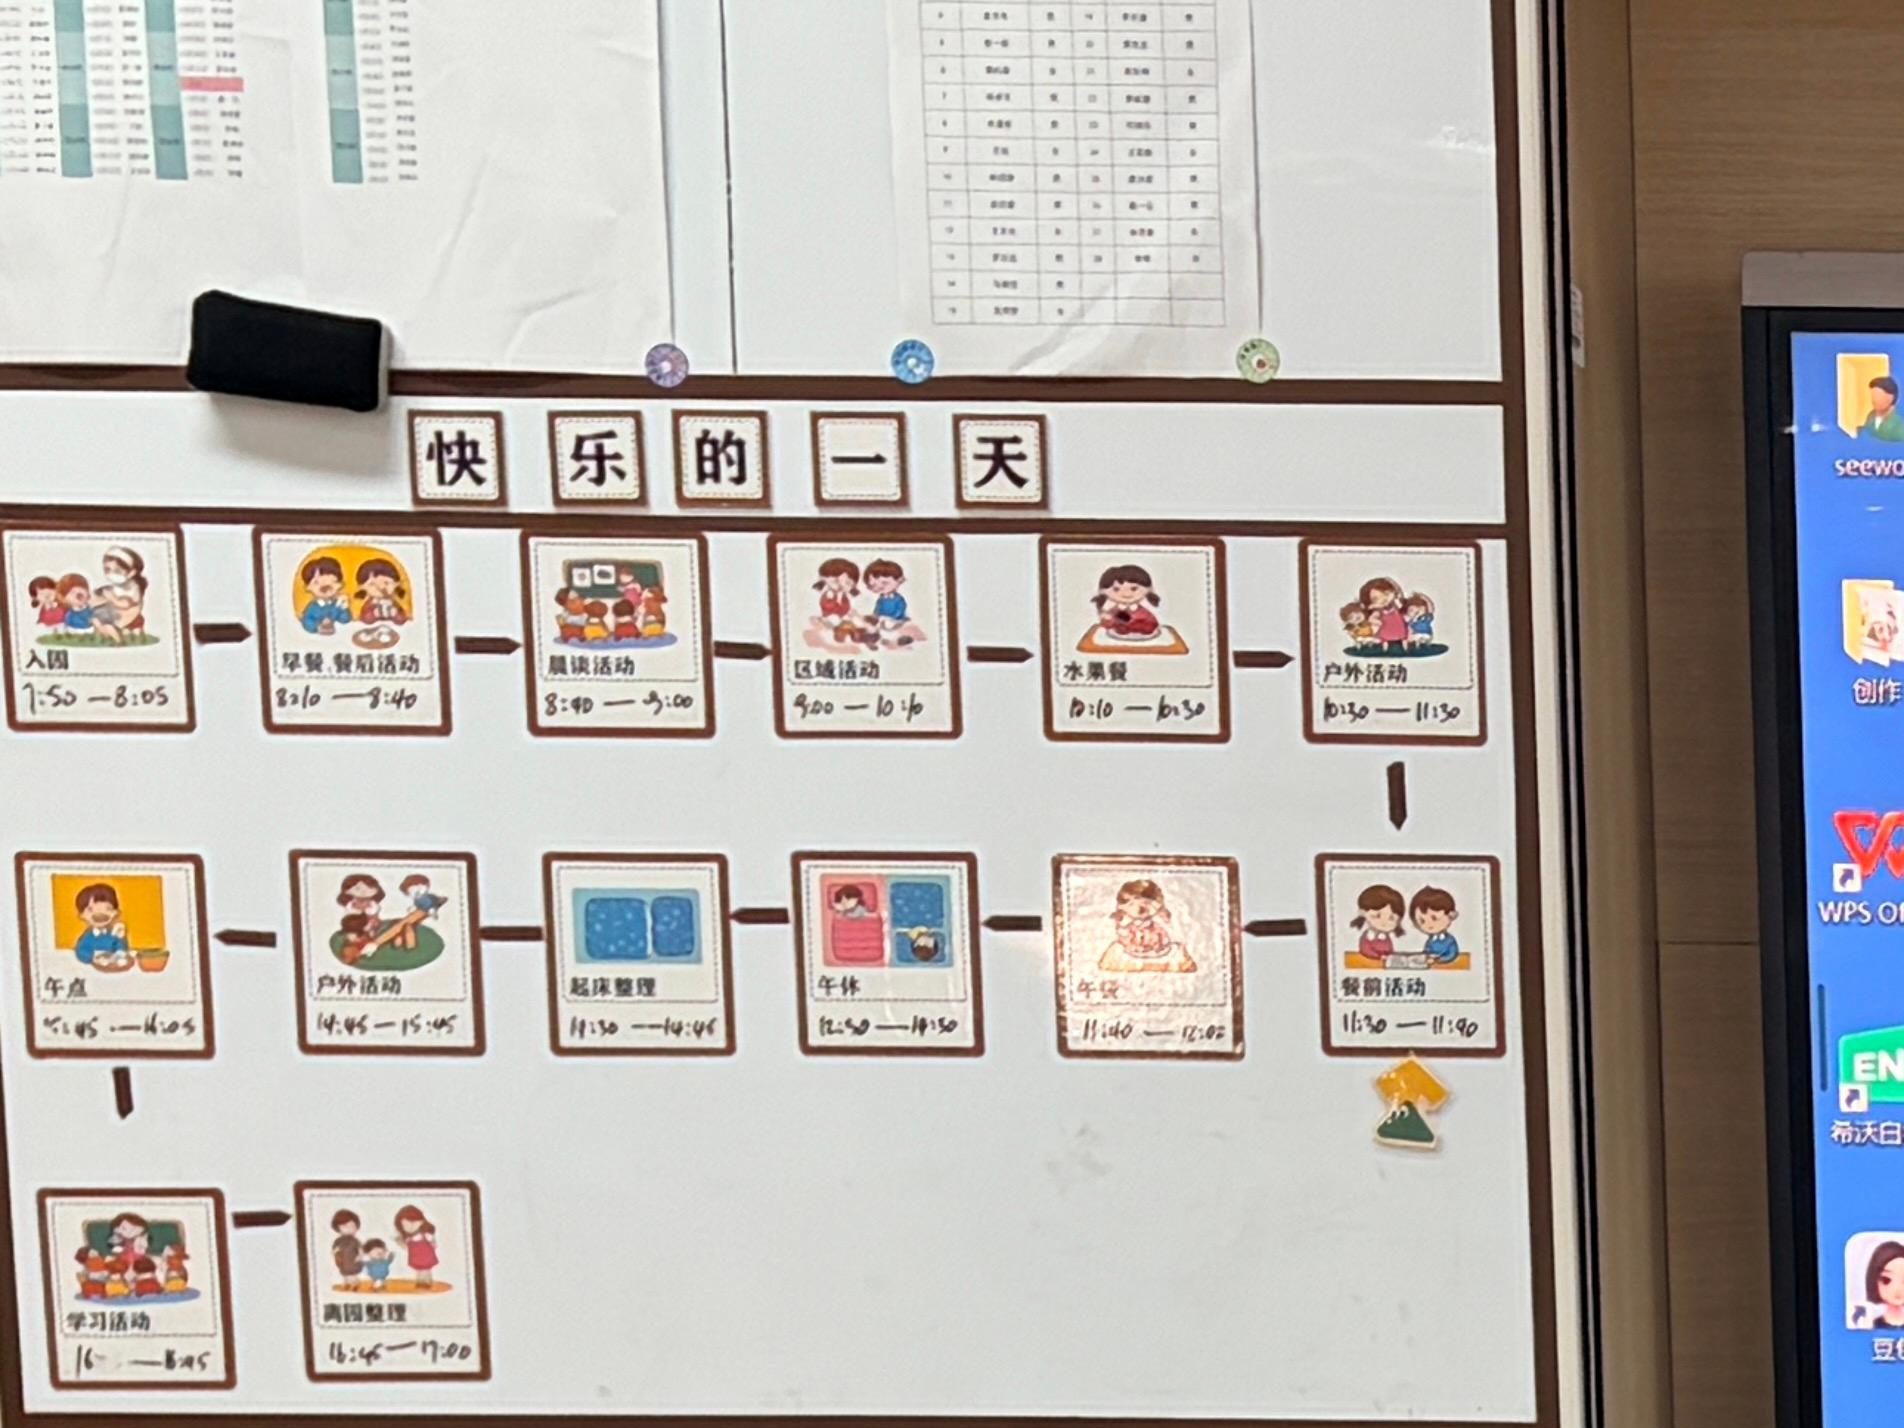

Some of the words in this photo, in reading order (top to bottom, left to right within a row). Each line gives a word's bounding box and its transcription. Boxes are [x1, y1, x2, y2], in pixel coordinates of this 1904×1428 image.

[426, 429, 1030, 488] 快乐的一天
[26, 649, 69, 670] 入园
[794, 659, 881, 680] 区域活动
[1063, 660, 1128, 682] 水果餐
[1323, 662, 1408, 684] 户外活动
[1853, 677, 1904, 703] 创作
[1818, 902, 1872, 925] WPS
[317, 974, 402, 995] 户外活动
[66, 1311, 151, 1332] 学习活动
